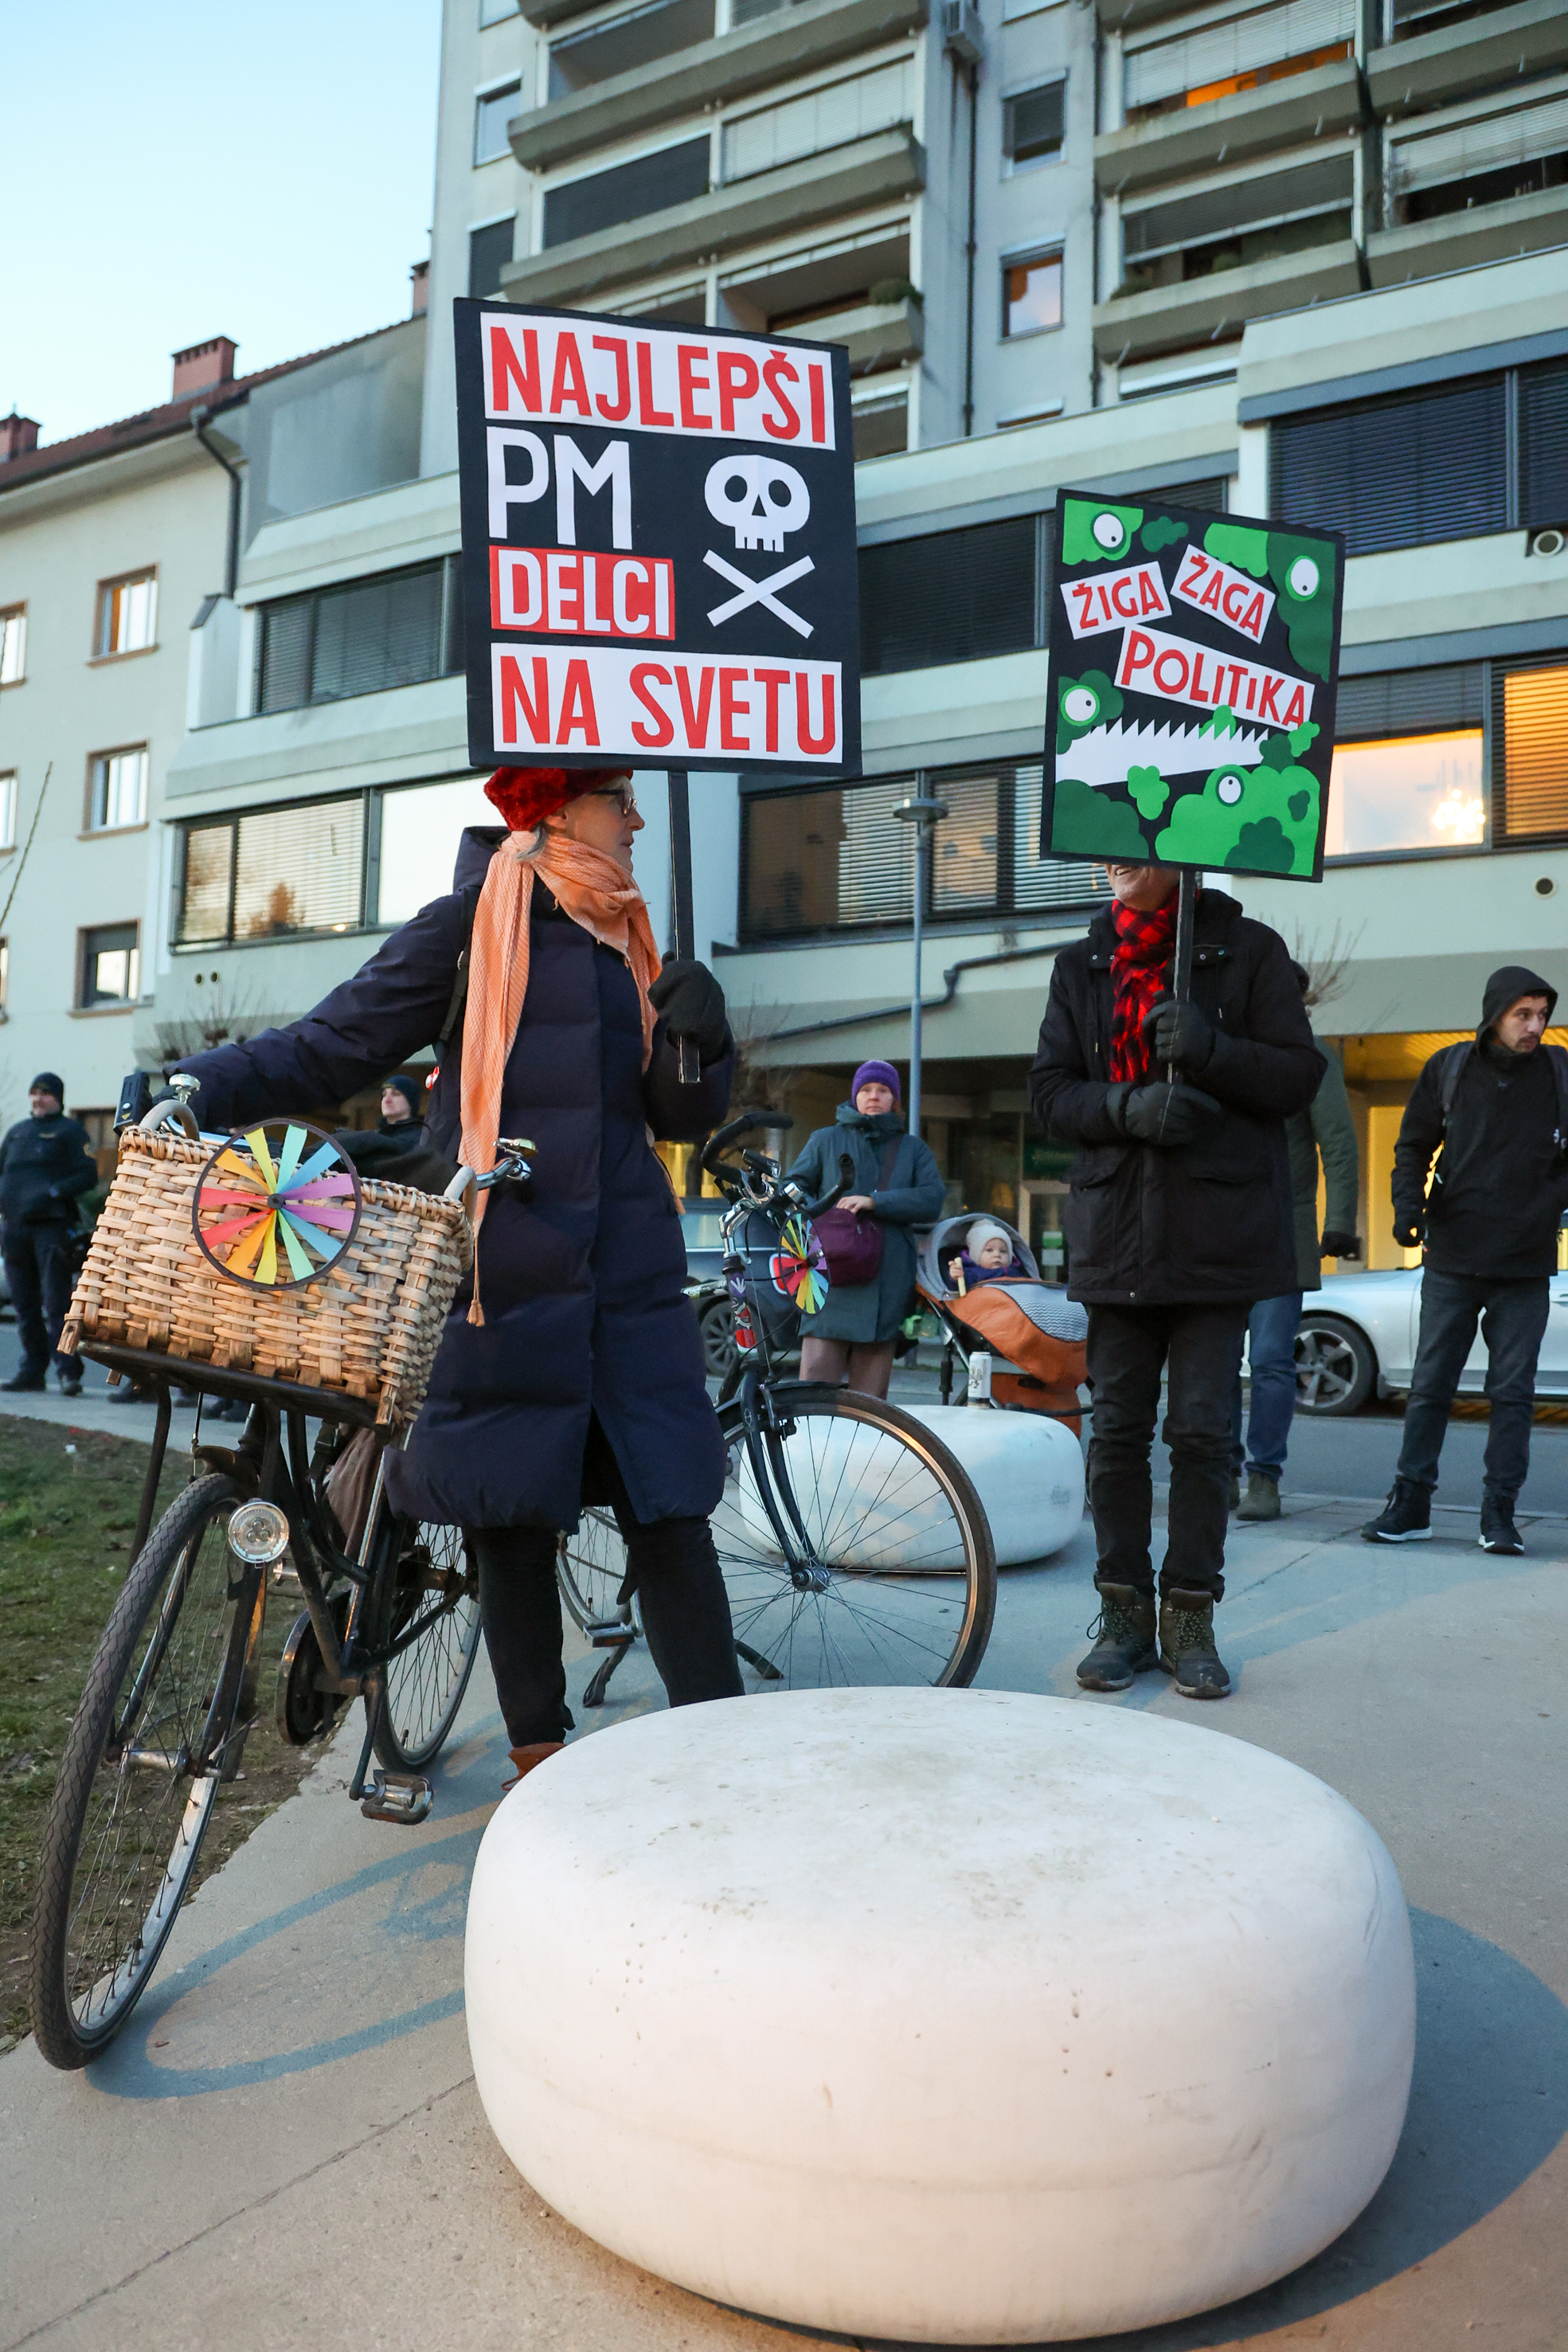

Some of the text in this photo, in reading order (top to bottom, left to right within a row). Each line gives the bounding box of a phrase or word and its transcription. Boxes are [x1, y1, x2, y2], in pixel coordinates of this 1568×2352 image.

[490, 327, 826, 444] NAJLEPŠI
[486, 425, 632, 550] PM
[499, 549, 669, 636] DELCI
[1072, 554, 1265, 639] ŽIGA ŽAGA
[500, 655, 836, 755] NA SVETU
[1120, 630, 1304, 729] POLITIKA
